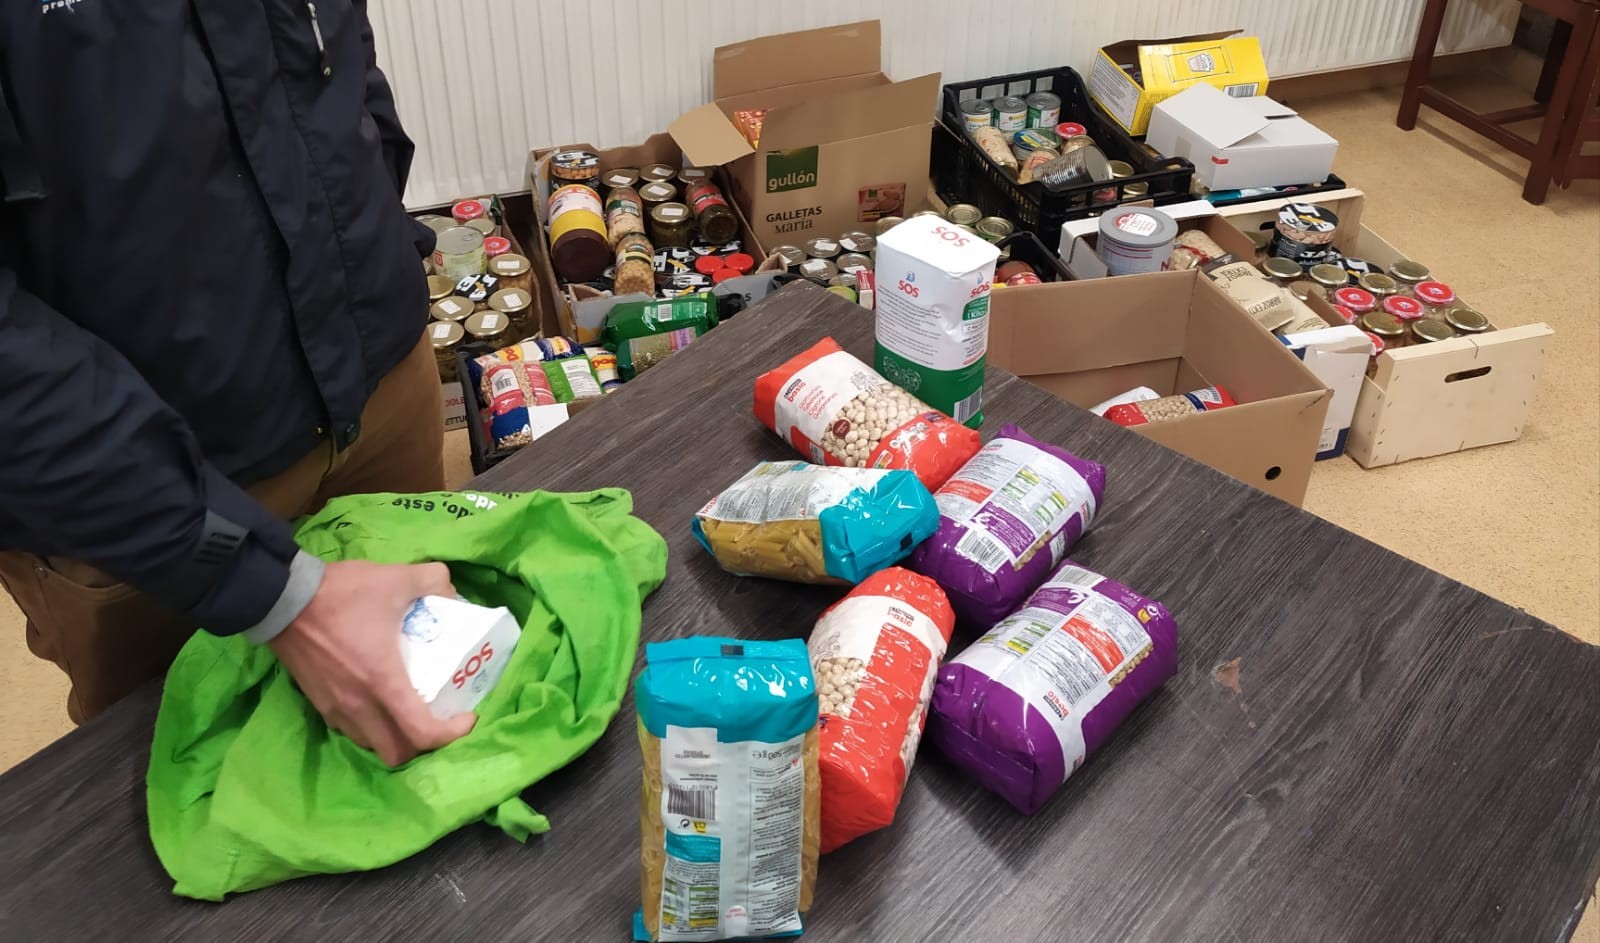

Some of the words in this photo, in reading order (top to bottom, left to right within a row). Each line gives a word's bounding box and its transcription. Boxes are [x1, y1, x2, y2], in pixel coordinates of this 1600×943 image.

[769, 170, 815, 191] gullón
[766, 206, 822, 223] GALLETAS
[931, 226, 970, 248] SOS
[898, 280, 919, 298] SOS
[970, 281, 990, 298] SOS
[788, 381, 806, 402] basic
[391, 497, 435, 512] este
[441, 500, 475, 520] do,
[452, 641, 494, 690] SOS
[1047, 690, 1070, 718] basic
